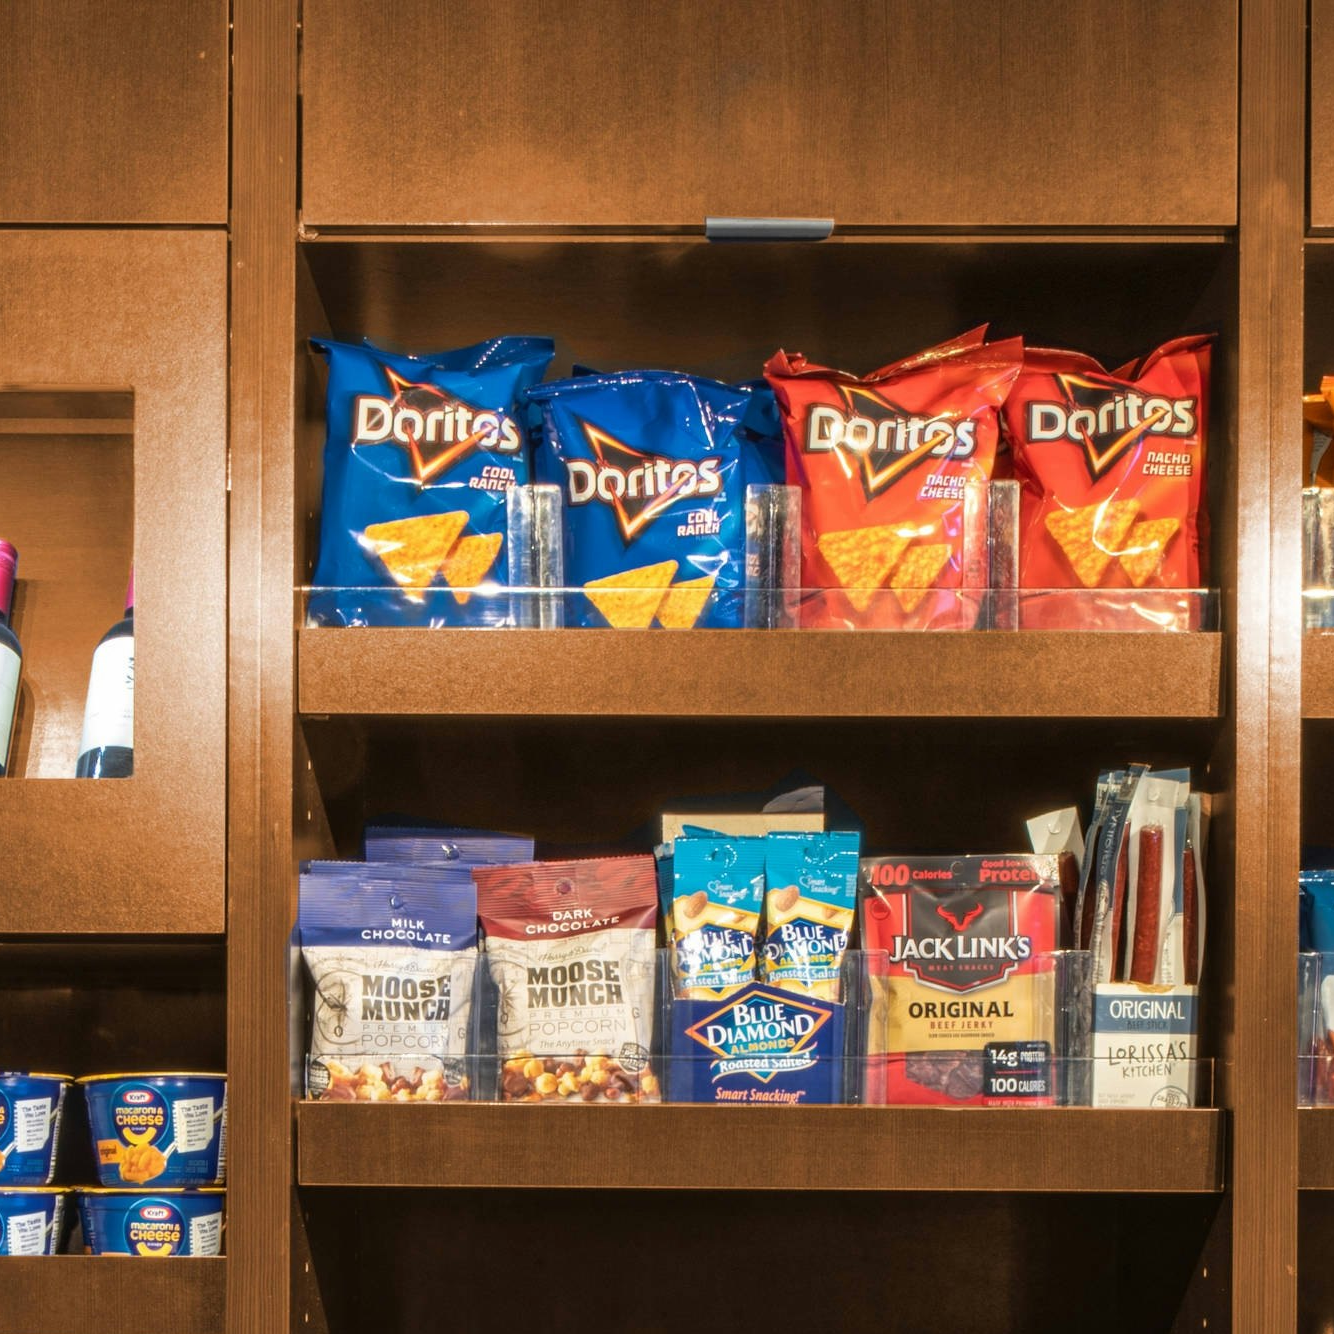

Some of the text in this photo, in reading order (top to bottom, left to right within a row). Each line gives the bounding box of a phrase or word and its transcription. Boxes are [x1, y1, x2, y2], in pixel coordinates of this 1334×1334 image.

[354, 396, 522, 452] Doritos
[1030, 391, 1197, 441] Doritos
[807, 404, 976, 456] Doritos
[1147, 451, 1191, 464] NACHO
[1142, 462, 1192, 476] CHEESE
[569, 458, 721, 504] Doritos
[925, 475, 966, 488] NACHO
[921, 486, 966, 500] CHEESE
[677, 522, 720, 537] RANCH
[871, 864, 953, 886] 100 Calories
[552, 908, 593, 922] DARK
[391, 918, 425, 931] MILK
[525, 915, 620, 935] CHOCOLATE
[782, 923, 824, 942] BLUE
[361, 929, 451, 944] CHOCOLATE
[890, 934, 1031, 963] JACK LINK'S
[527, 960, 620, 985] MOOSE
[362, 974, 451, 999] MOOSE
[527, 984, 624, 1009] MUNCH
[361, 999, 450, 1022] MUNCH
[733, 1003, 785, 1026] BLUE
[908, 1001, 1014, 1018] ORIGINAL
[1109, 1000, 1185, 1020] ORIGINAL
[529, 1018, 627, 1036] POPCORN
[706, 1014, 815, 1047] DIAMOND
[930, 1021, 994, 1029] BEEF JERKY
[361, 1034, 449, 1050] POPCORN
[730, 1037, 796, 1055] ALMONDS
[719, 1052, 812, 1074] Roasted Salted
[990, 1049, 1018, 1067] 14g
[715, 1087, 748, 1101] Smart
[990, 1078, 1046, 1093] 100 CALORIES
[116, 1106, 157, 1115] macaroni
